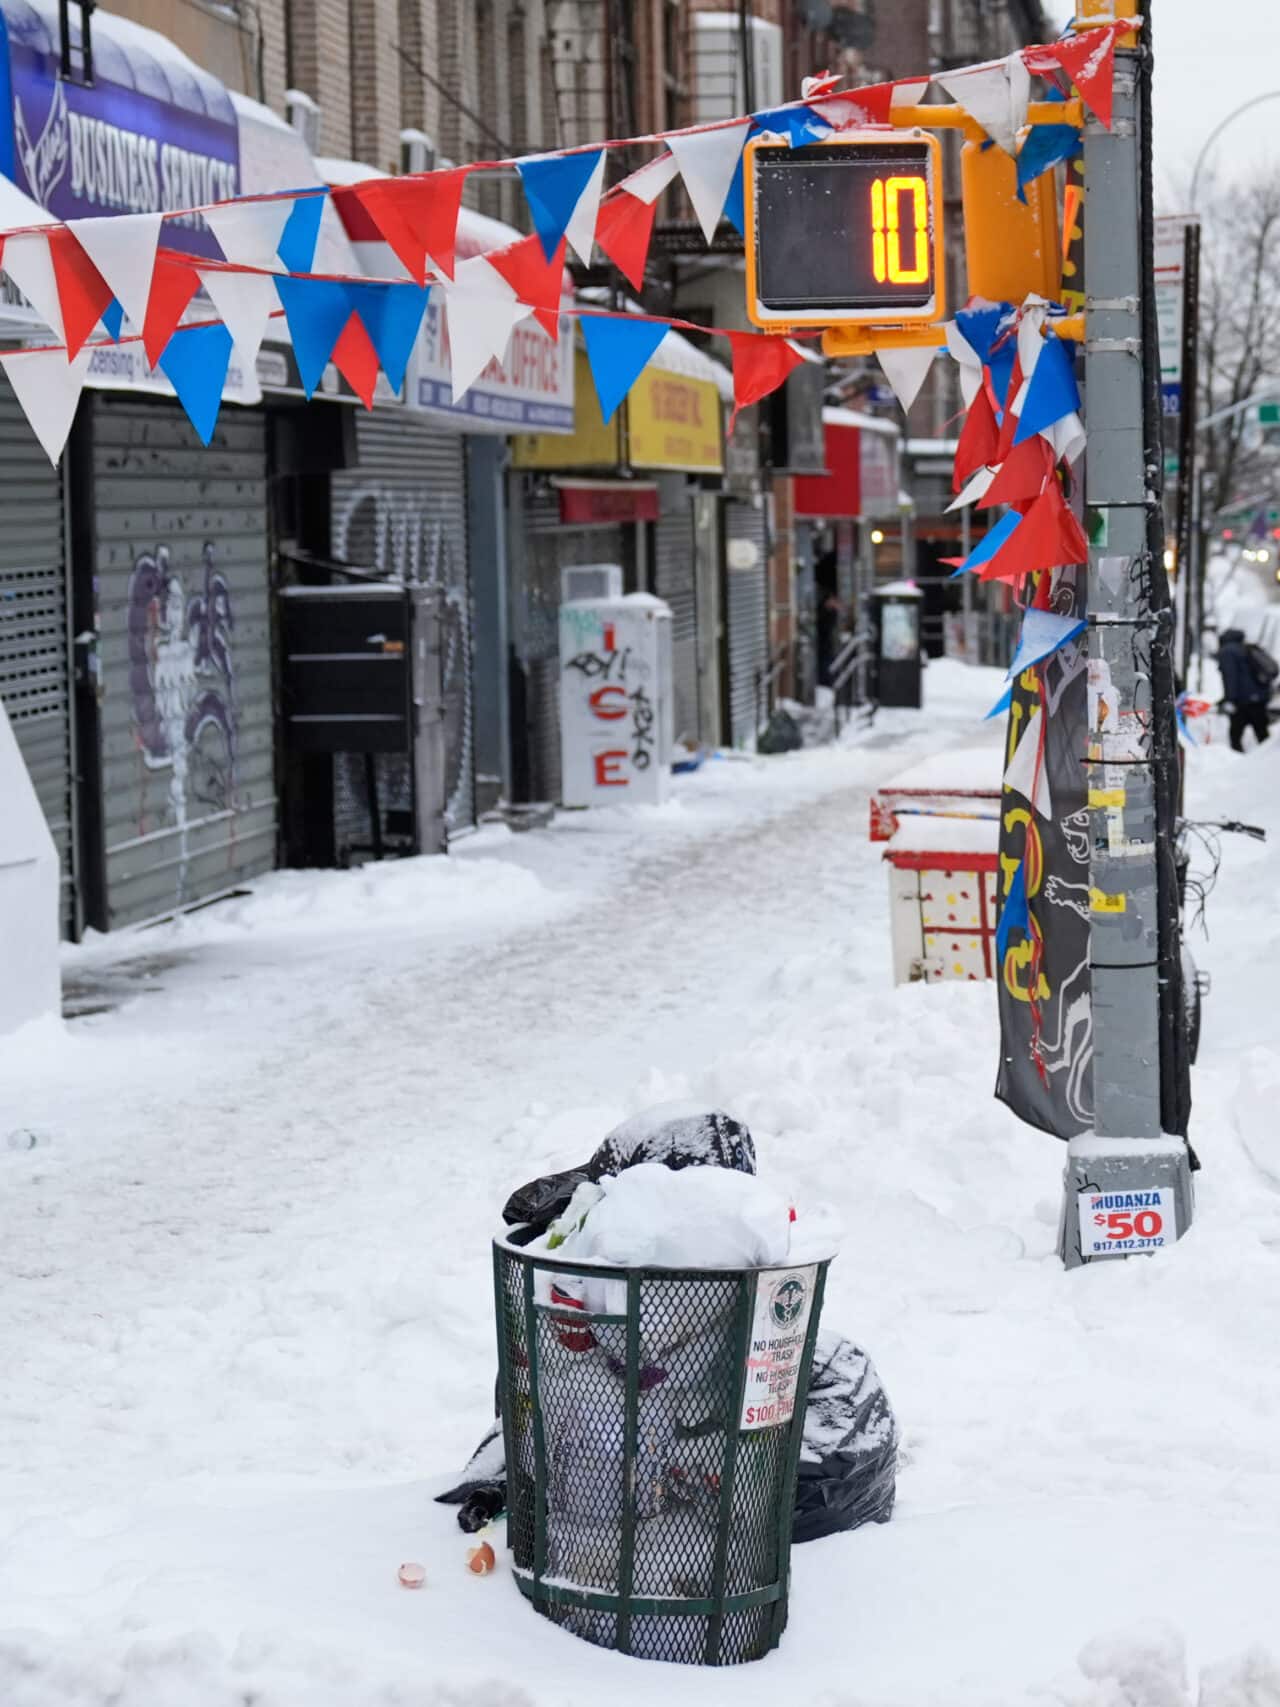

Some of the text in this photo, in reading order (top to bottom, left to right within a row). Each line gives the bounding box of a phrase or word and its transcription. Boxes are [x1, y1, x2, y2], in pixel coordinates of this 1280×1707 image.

[68, 112, 159, 213] BUSINESS
[871, 177, 929, 283] 10
[1091, 1192, 1161, 1209] MUDANZA
[1093, 1211, 1162, 1239] $50
[1093, 1238, 1164, 1251] 917.412.3712
[753, 1341, 766, 1352] NO
[756, 1371, 768, 1383] NO
[746, 1404, 775, 1424] $100
